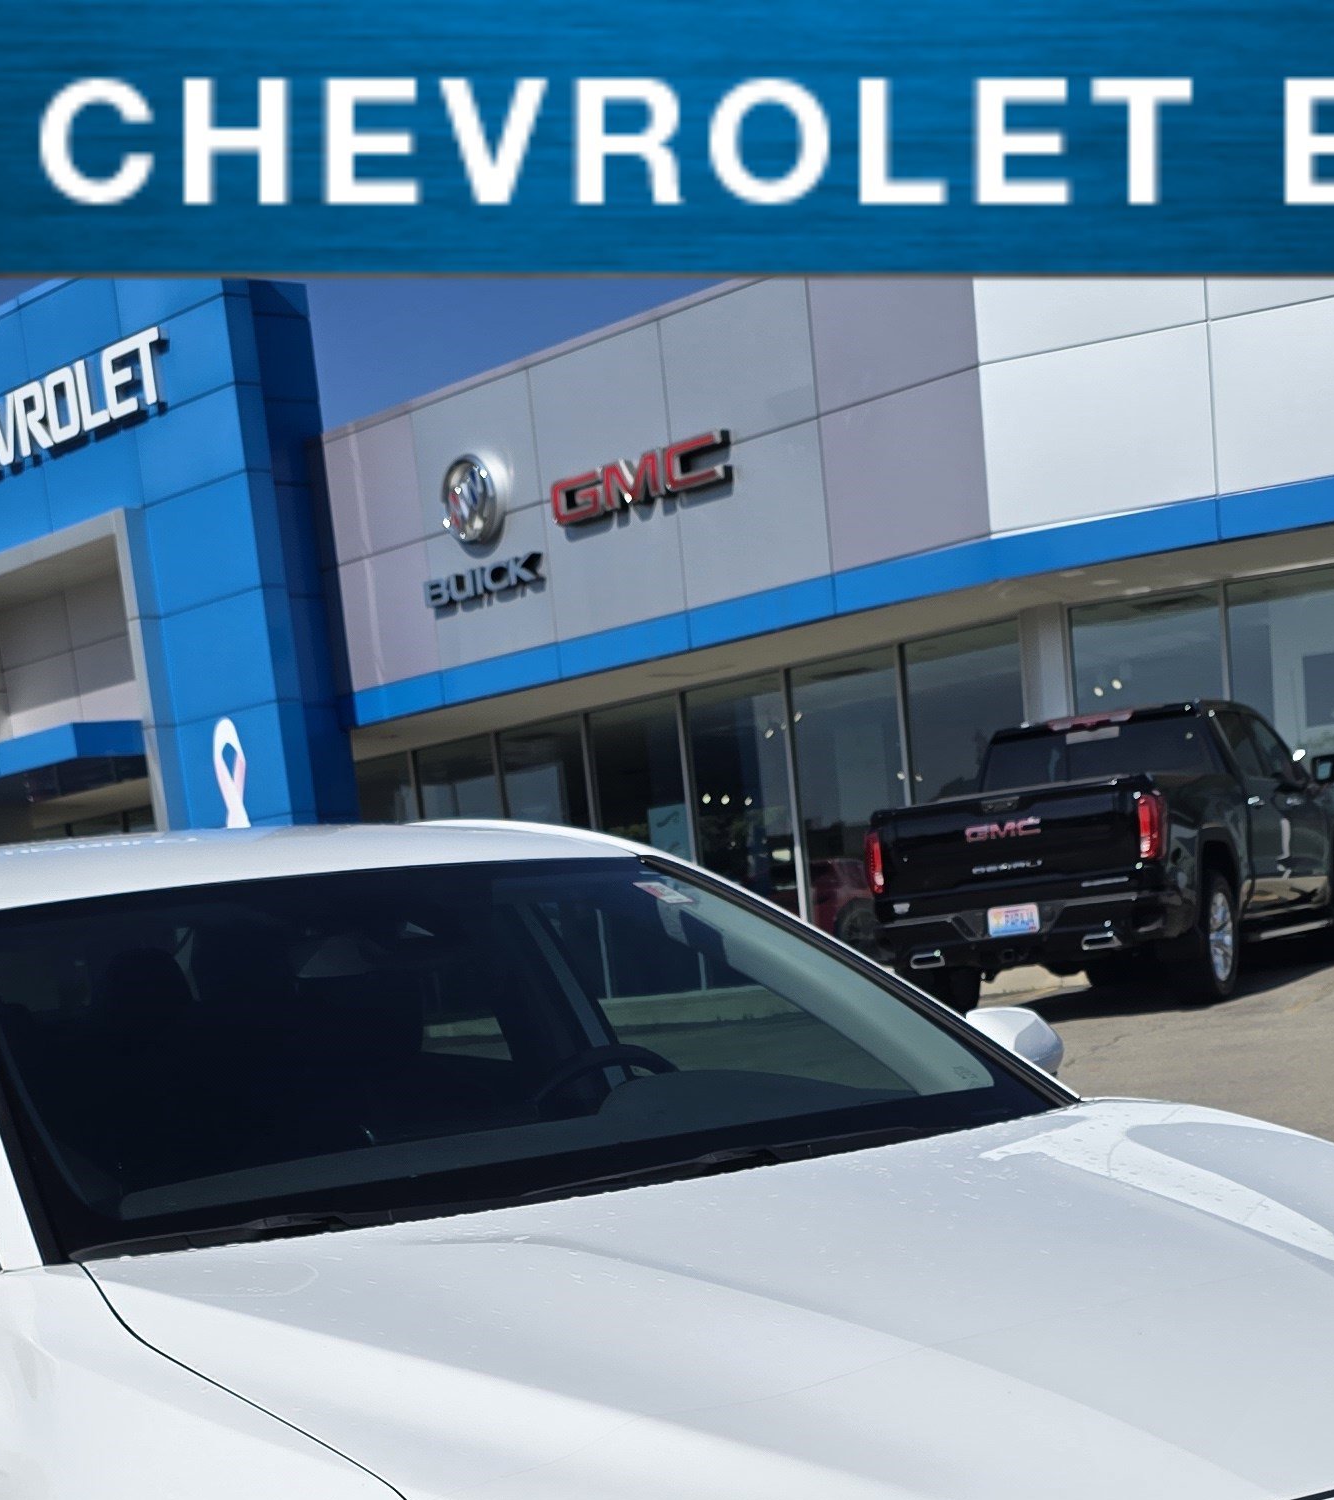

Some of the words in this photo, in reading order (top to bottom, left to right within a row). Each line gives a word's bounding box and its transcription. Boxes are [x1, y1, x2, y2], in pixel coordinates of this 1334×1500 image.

[550, 431, 731, 526] GMC
[423, 552, 543, 608] BUICK
[965, 816, 1042, 843] GMC
